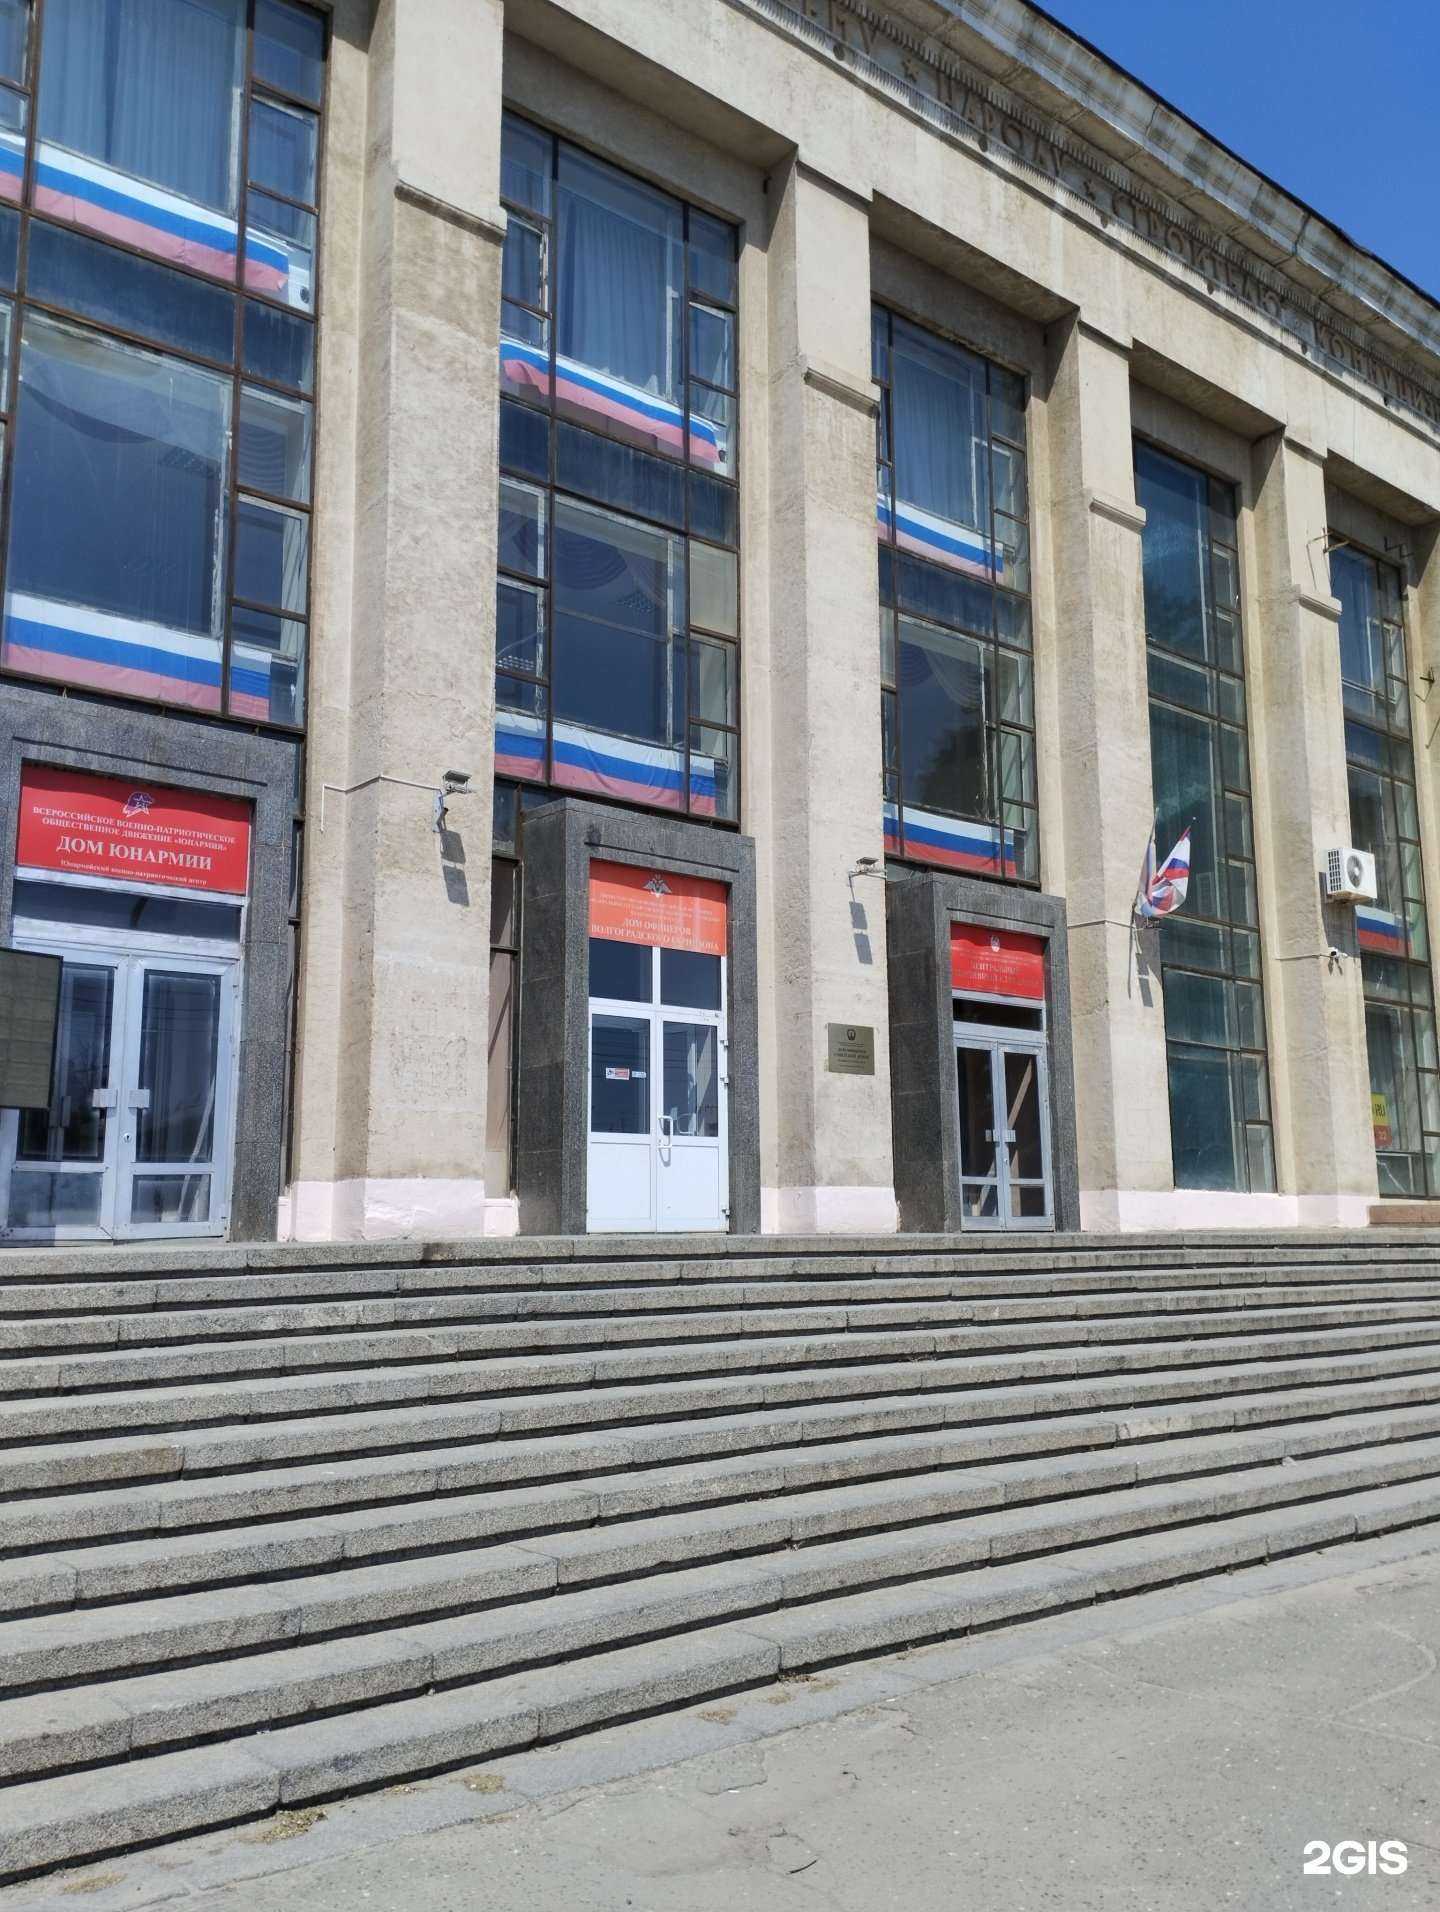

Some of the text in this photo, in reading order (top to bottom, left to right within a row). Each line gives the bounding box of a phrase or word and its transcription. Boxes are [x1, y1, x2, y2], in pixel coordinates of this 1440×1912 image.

[33, 806, 236, 844] ВСЕРОССИЙСКОЕ ВОЕННО-ПАТРИОТИЧЕСКОЕ
[42, 817, 121, 836] ОБЩЕСТВЕННОЕ
[121, 829, 173, 845] ДВИЖЕНИЕ
[56, 835, 212, 871] ДОМ ЮНАРМИИ
